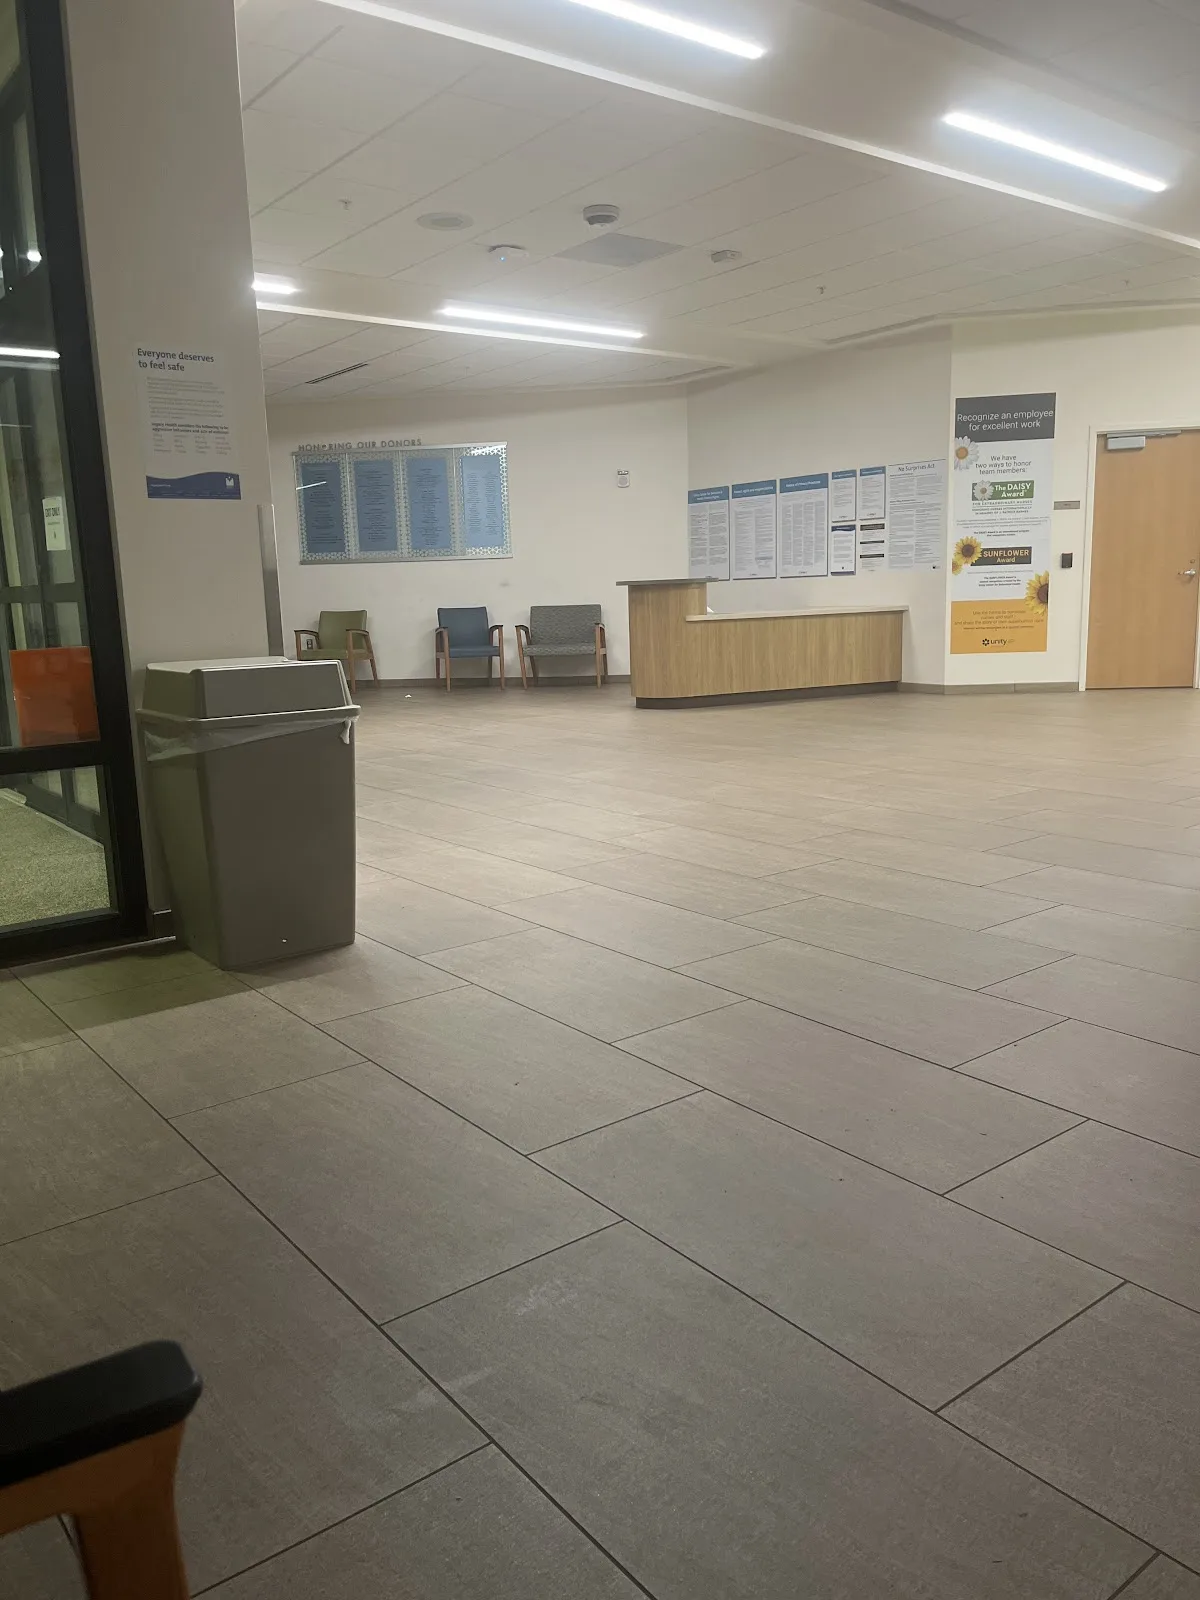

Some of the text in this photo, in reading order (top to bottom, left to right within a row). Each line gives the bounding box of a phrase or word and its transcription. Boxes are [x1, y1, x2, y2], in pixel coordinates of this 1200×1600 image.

[137, 348, 214, 363] Everyone deserves
[138, 360, 185, 371] to feel safe
[957, 409, 1053, 423] Recognize an employee
[969, 420, 1041, 431] for excellent work
[357, 441, 376, 449] OUR
[381, 438, 422, 448] DONORS
[1007, 482, 1031, 490] DAISY
[983, 549, 1029, 557] SUNFLOWER
